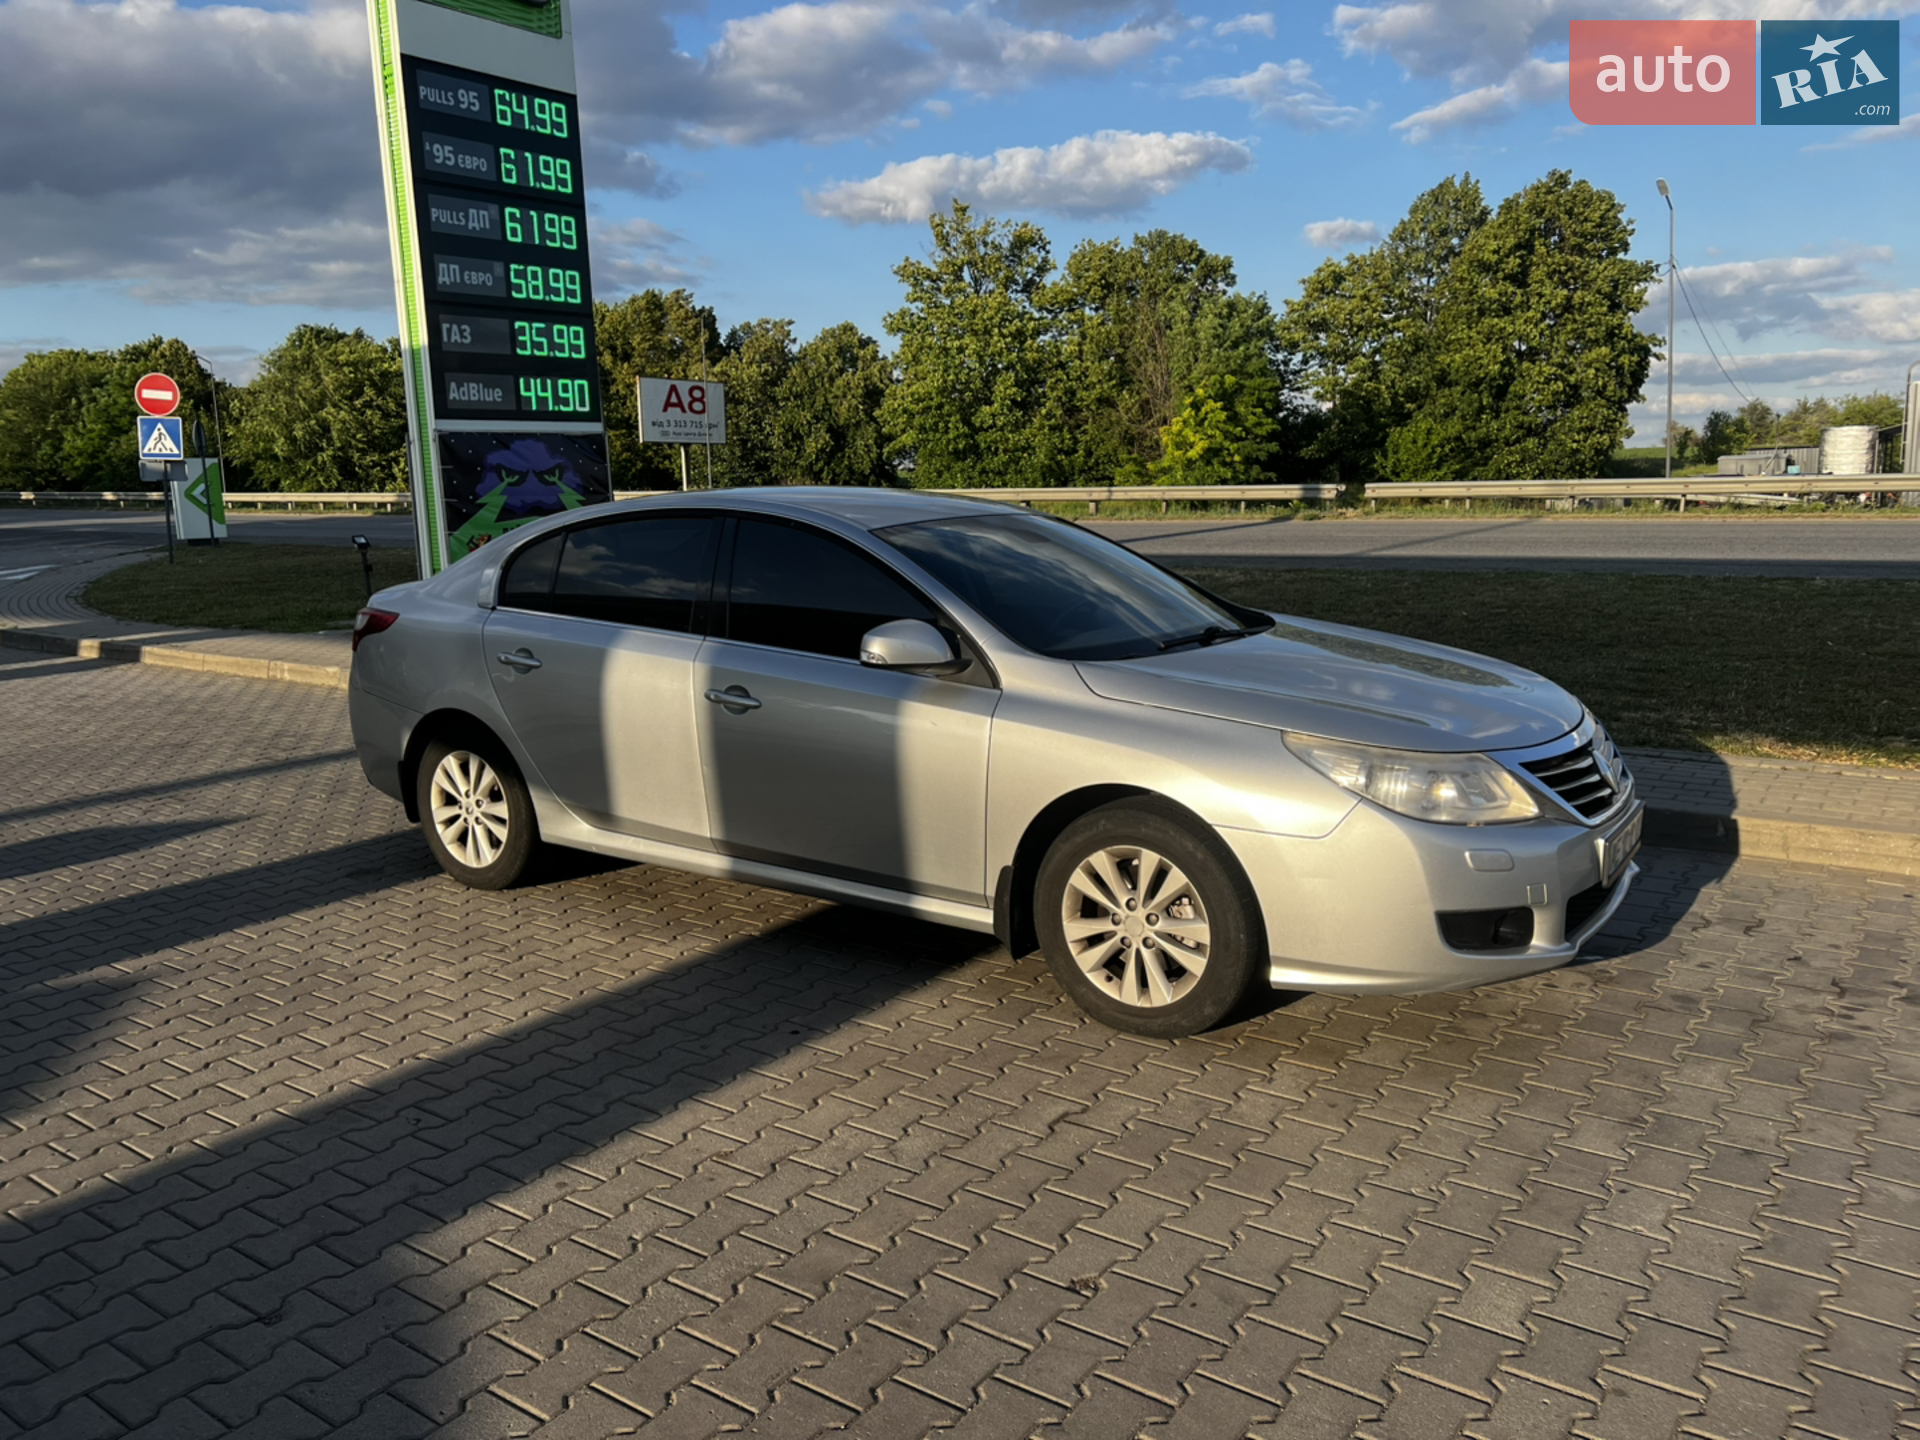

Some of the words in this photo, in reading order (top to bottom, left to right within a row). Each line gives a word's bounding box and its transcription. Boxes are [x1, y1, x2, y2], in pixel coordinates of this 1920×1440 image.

[419, 85, 455, 106] PULLS
[457, 88, 480, 112] 95
[494, 88, 569, 138] 64.99
[457, 154, 487, 172] ЄВРО
[499, 147, 573, 193] 61.99
[431, 207, 466, 226] PULLS
[468, 208, 490, 231] ДП
[438, 263, 461, 285] ДП
[464, 270, 493, 286] ЄВРО
[509, 263, 581, 304] 58.99
[441, 323, 472, 344] ГАЗ
[514, 321, 586, 359] 35.99
[449, 382, 503, 402] AdBlue
[519, 377, 590, 412] 44.90
[662, 384, 706, 415] A8
